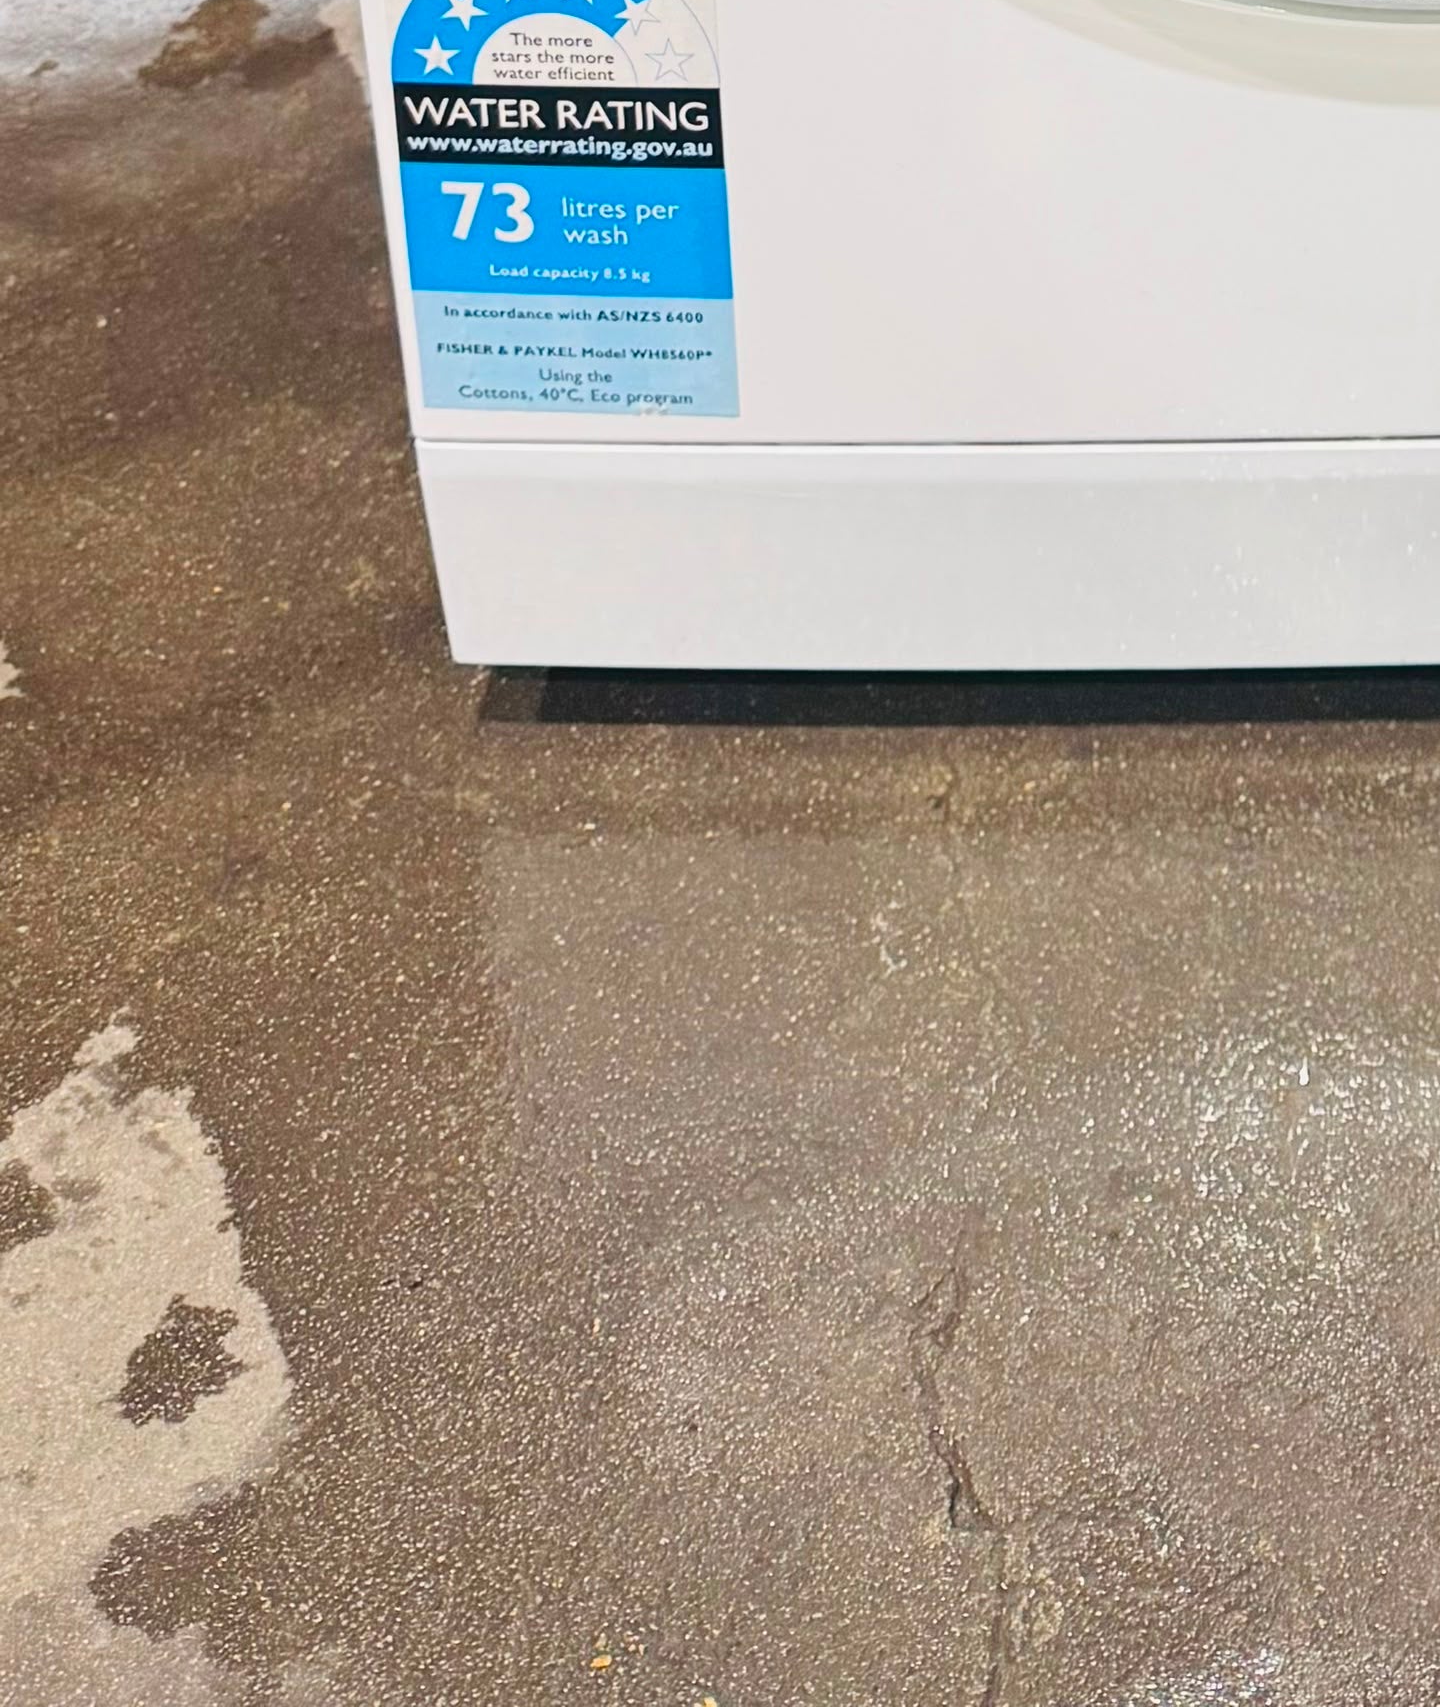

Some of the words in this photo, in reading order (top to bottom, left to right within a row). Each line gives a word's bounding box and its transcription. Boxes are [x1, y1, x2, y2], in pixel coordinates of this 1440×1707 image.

[510, 33, 542, 48] The
[548, 36, 592, 48] more
[492, 50, 532, 64] stars
[538, 50, 564, 64] the
[569, 53, 614, 65] more
[494, 68, 542, 81] water
[548, 66, 614, 81] efficient
[404, 97, 546, 129] WATER
[557, 102, 709, 131] RATING
[407, 136, 713, 160] www.waterrating.gov.au
[440, 181, 535, 243] 73
[562, 198, 627, 219] litres
[636, 203, 679, 224] per
[564, 225, 628, 245] wash
[490, 266, 529, 278] Load
[533, 267, 599, 282] capacity
[604, 268, 627, 280] 8.5
[632, 269, 650, 283] kg
[444, 306, 459, 317] In
[464, 307, 552, 320] accordance
[558, 309, 592, 321] with
[597, 310, 661, 323] AS/NZS
[666, 311, 703, 323] 6400
[437, 343, 493, 355] FISHER
[498, 345, 508, 356] &
[514, 346, 577, 357] PAYKEL
[582, 348, 626, 359] Model
[539, 368, 583, 385] Using
[587, 369, 612, 383] the
[459, 386, 533, 402] Cottons,
[591, 390, 621, 403] Eco
[627, 393, 693, 407] program
